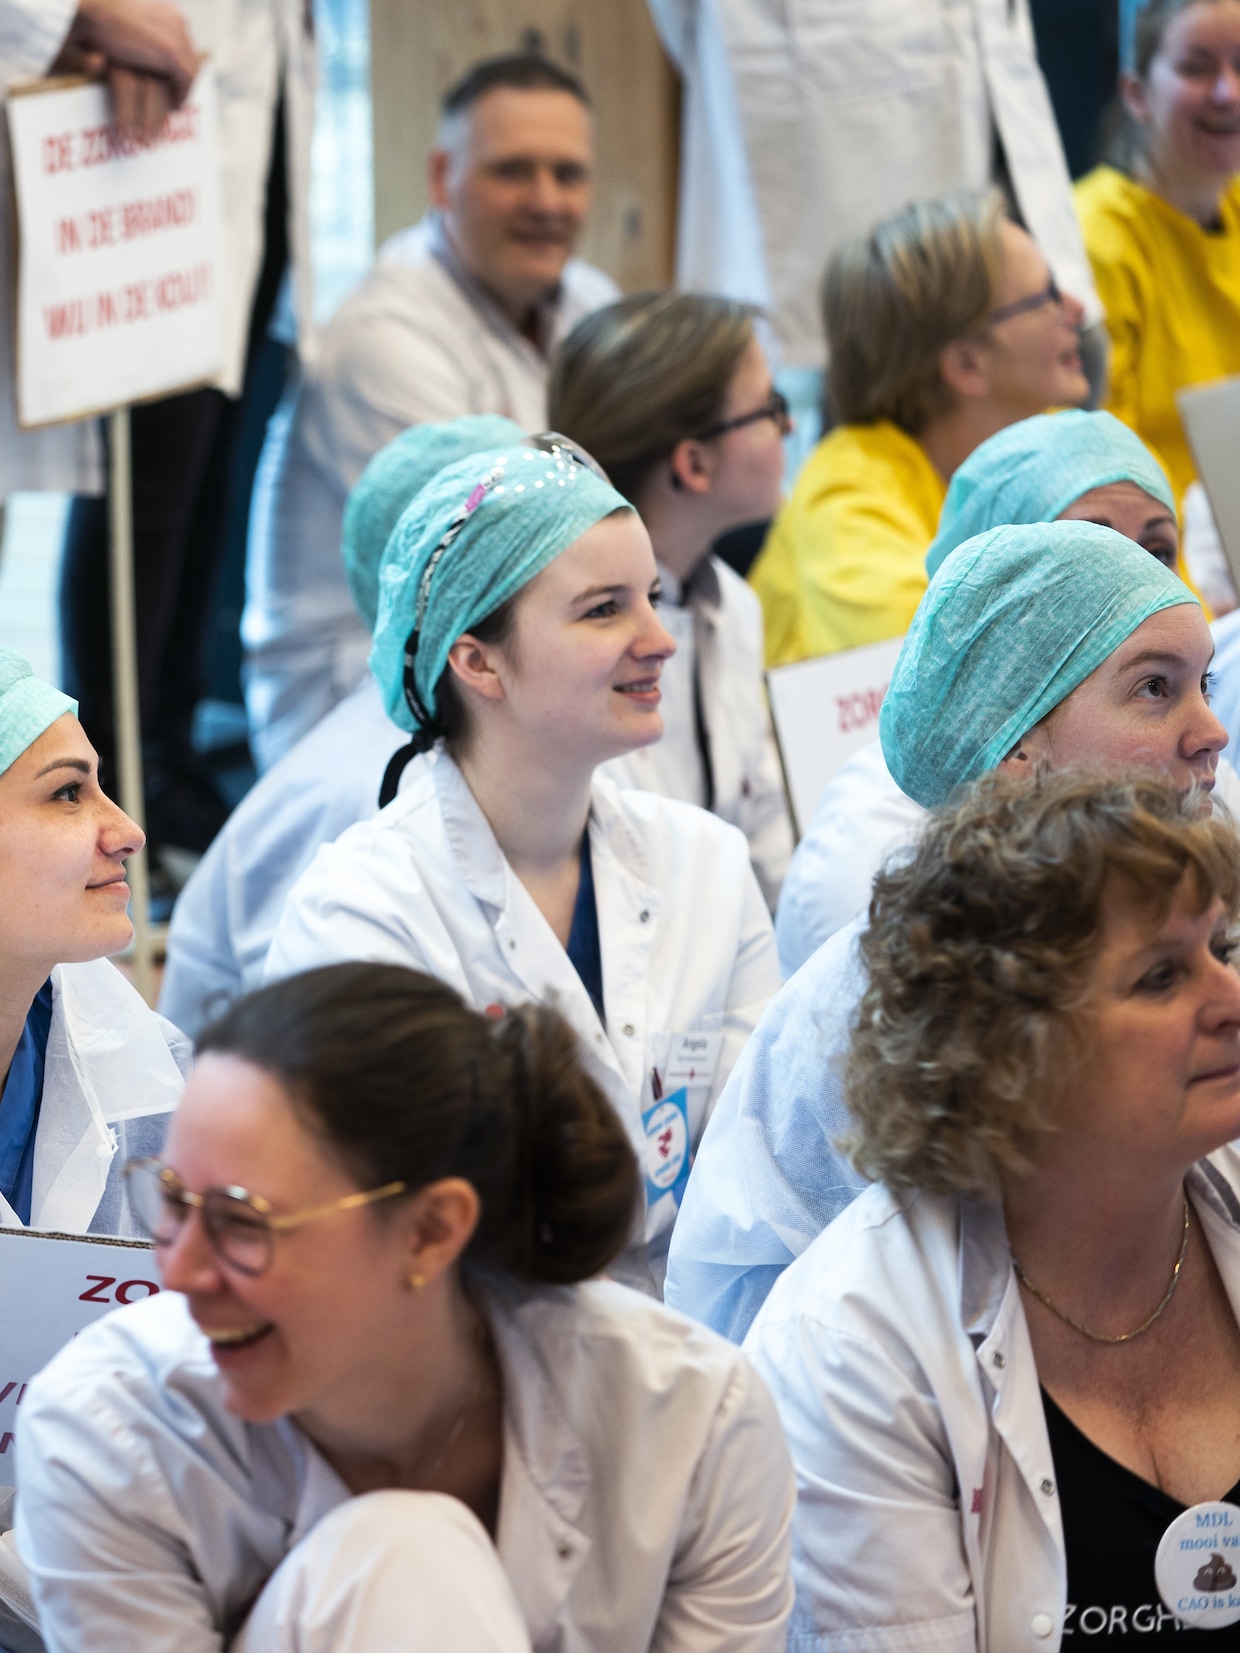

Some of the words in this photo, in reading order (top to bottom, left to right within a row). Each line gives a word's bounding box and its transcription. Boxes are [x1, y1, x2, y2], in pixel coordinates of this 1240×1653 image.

[44, 132, 72, 175] DE
[57, 216, 82, 255] IN
[88, 208, 114, 249] DE
[1195, 1511, 1234, 1529] MDL
[1179, 1532, 1218, 1551] mooi
[1177, 1596, 1209, 1612] CAO
[1212, 1594, 1225, 1609] is
[1062, 1603, 1188, 1635] ZORGH
